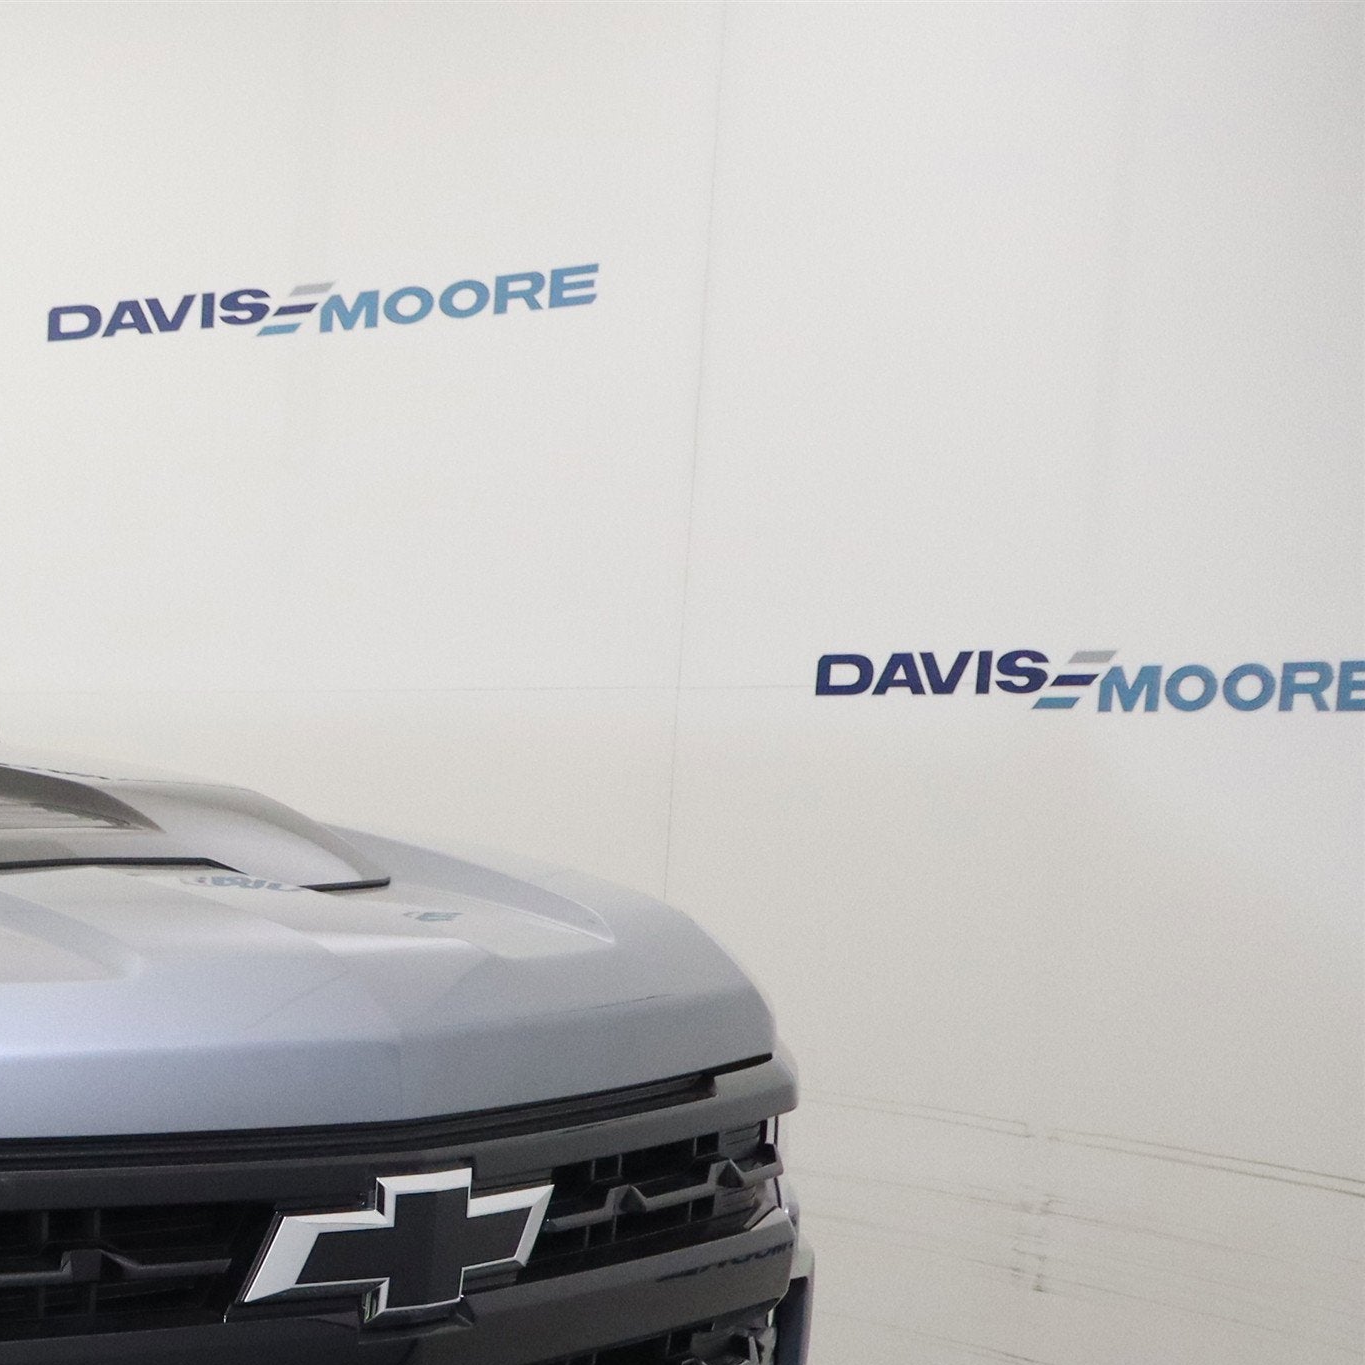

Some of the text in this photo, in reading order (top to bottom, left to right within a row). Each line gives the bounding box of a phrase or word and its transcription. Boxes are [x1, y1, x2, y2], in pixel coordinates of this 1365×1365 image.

[46, 263, 600, 343] DAVIS MOORE
[814, 648, 1050, 697] DAVIS
